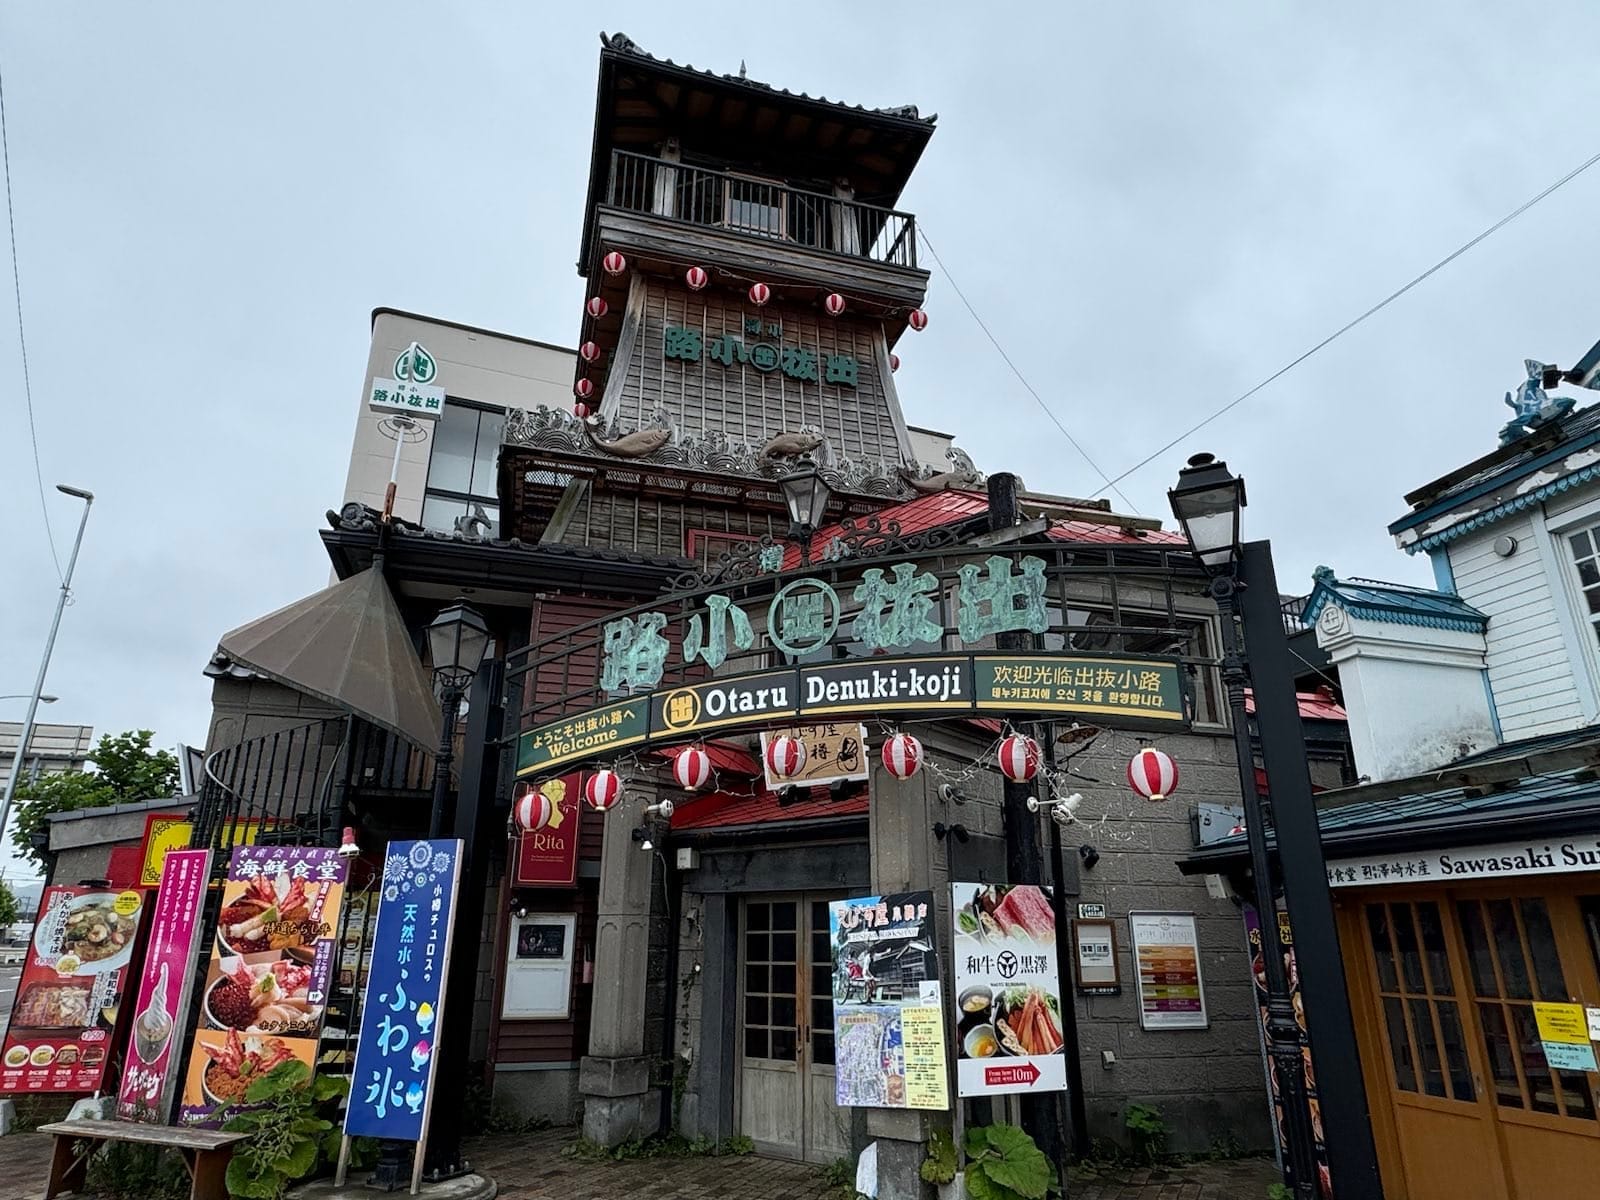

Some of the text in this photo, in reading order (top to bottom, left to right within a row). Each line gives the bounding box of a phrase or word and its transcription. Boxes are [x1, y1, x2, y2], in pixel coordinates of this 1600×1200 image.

[705, 666, 961, 717] Otaru Denuki-koji
[1056, 688, 1076, 701] 오신
[547, 728, 618, 758] Welcome
[533, 833, 565, 851] Rita
[235, 859, 342, 880] 海鮮食堂
[1439, 846, 1556, 875] Sawasaki
[966, 955, 1048, 974] 和牛 黒澤
[1012, 1068, 1034, 1081] 10m
